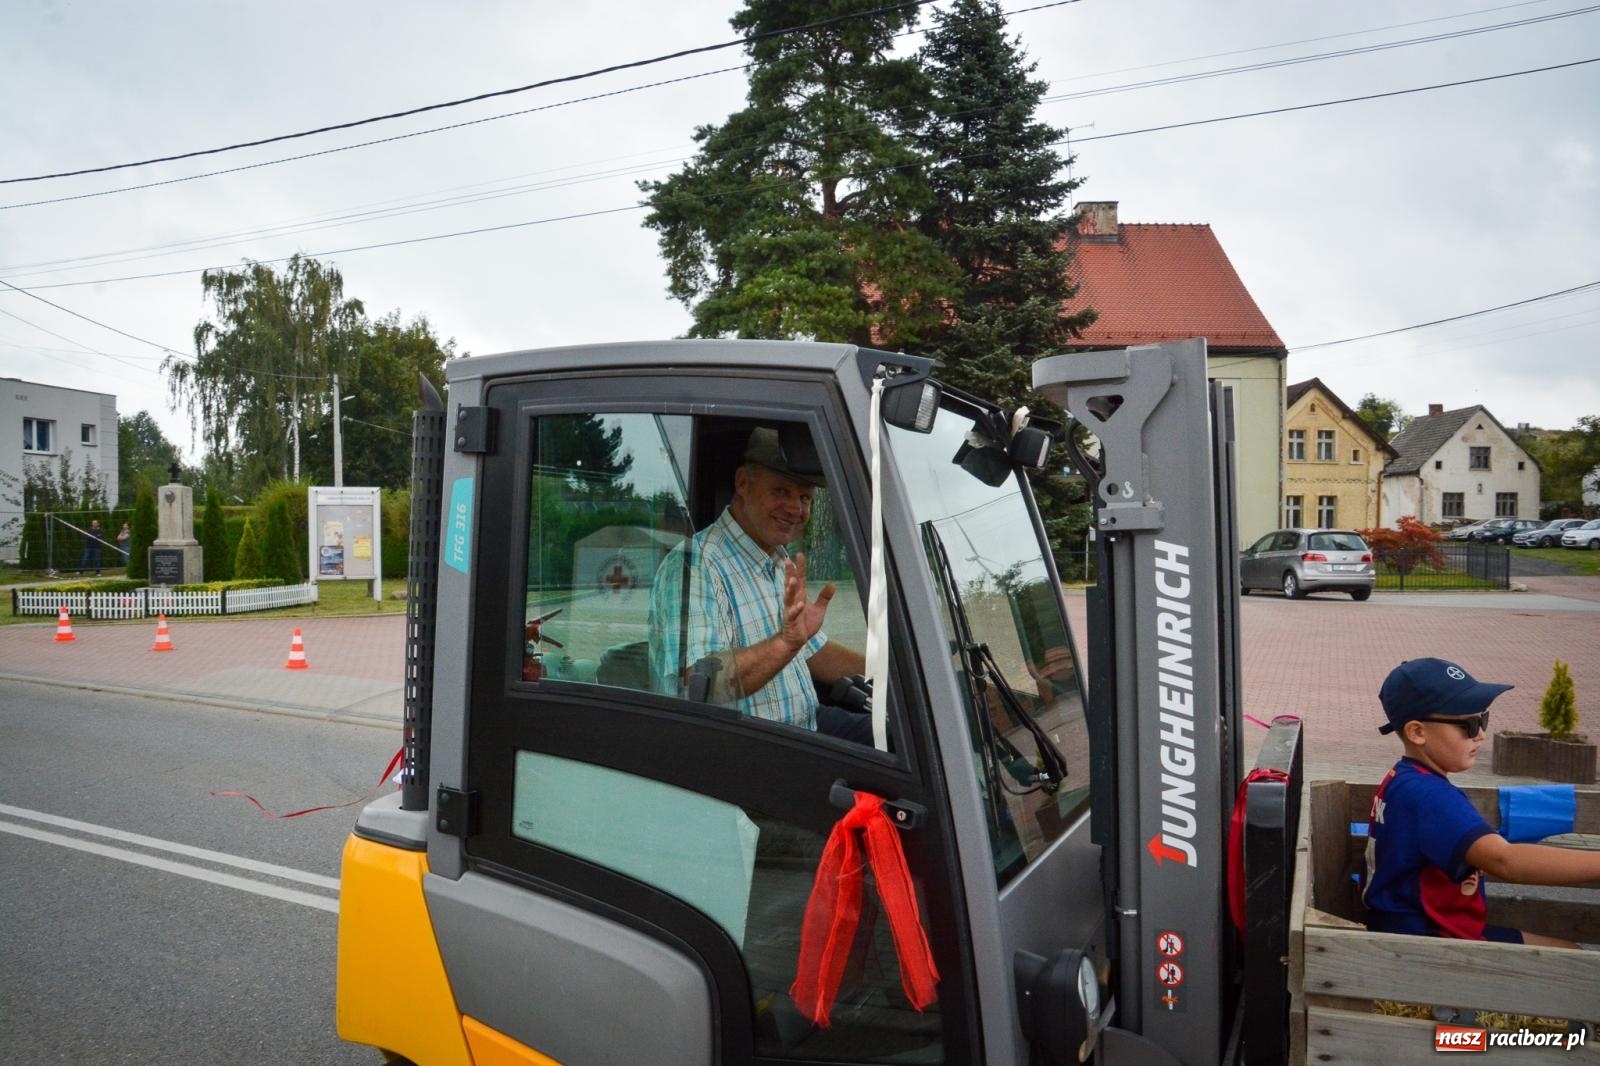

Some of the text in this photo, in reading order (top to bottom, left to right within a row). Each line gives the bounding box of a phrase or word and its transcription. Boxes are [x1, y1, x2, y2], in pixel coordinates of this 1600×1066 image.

[453, 503, 466, 562] TFG 316
[1153, 539, 1198, 867] JUNGHEINRICH
